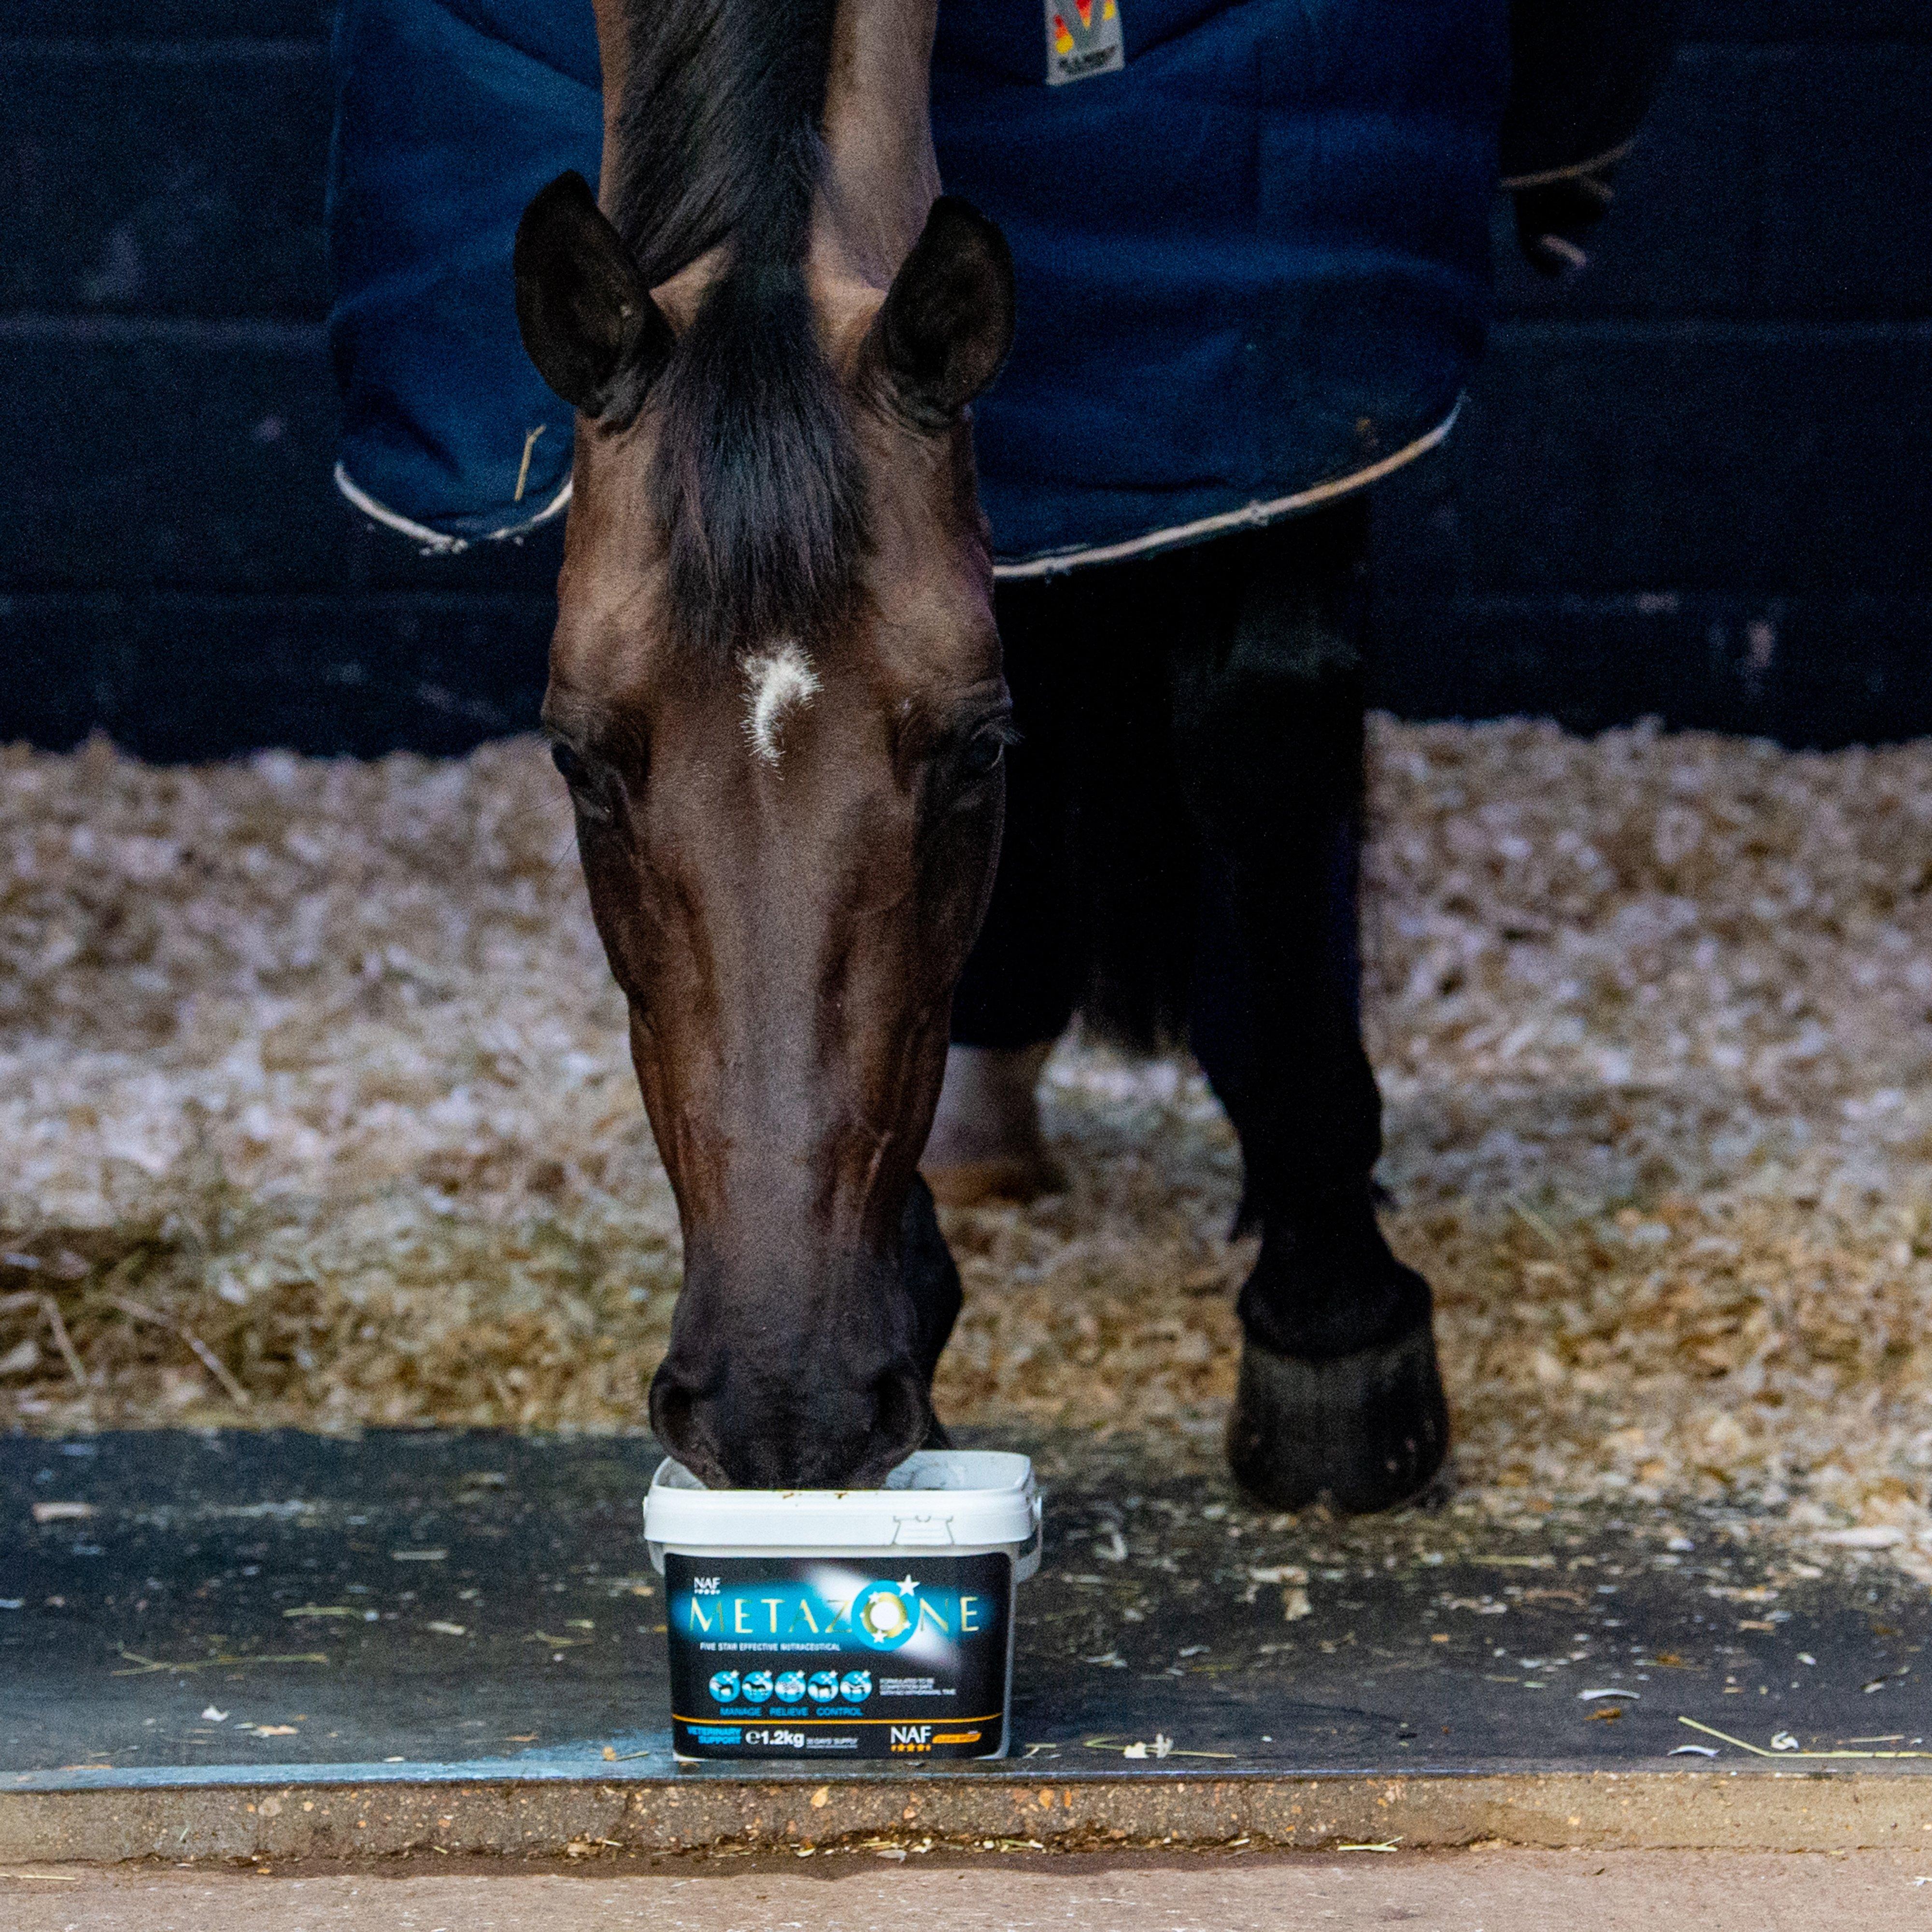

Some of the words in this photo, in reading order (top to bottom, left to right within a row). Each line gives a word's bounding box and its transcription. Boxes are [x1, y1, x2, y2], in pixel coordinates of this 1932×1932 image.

[694, 1577, 721, 1589] NAF
[689, 1592, 979, 1638] METAZONE
[700, 1642, 716, 1650] FIVE
[718, 1642, 738, 1651] STAR
[739, 1642, 778, 1651] EFFECTIVE
[720, 1706, 762, 1716] MANAGE
[769, 1706, 809, 1716] RELIEVE
[816, 1706, 864, 1717] CONTROL
[891, 1726, 932, 1744] NAF
